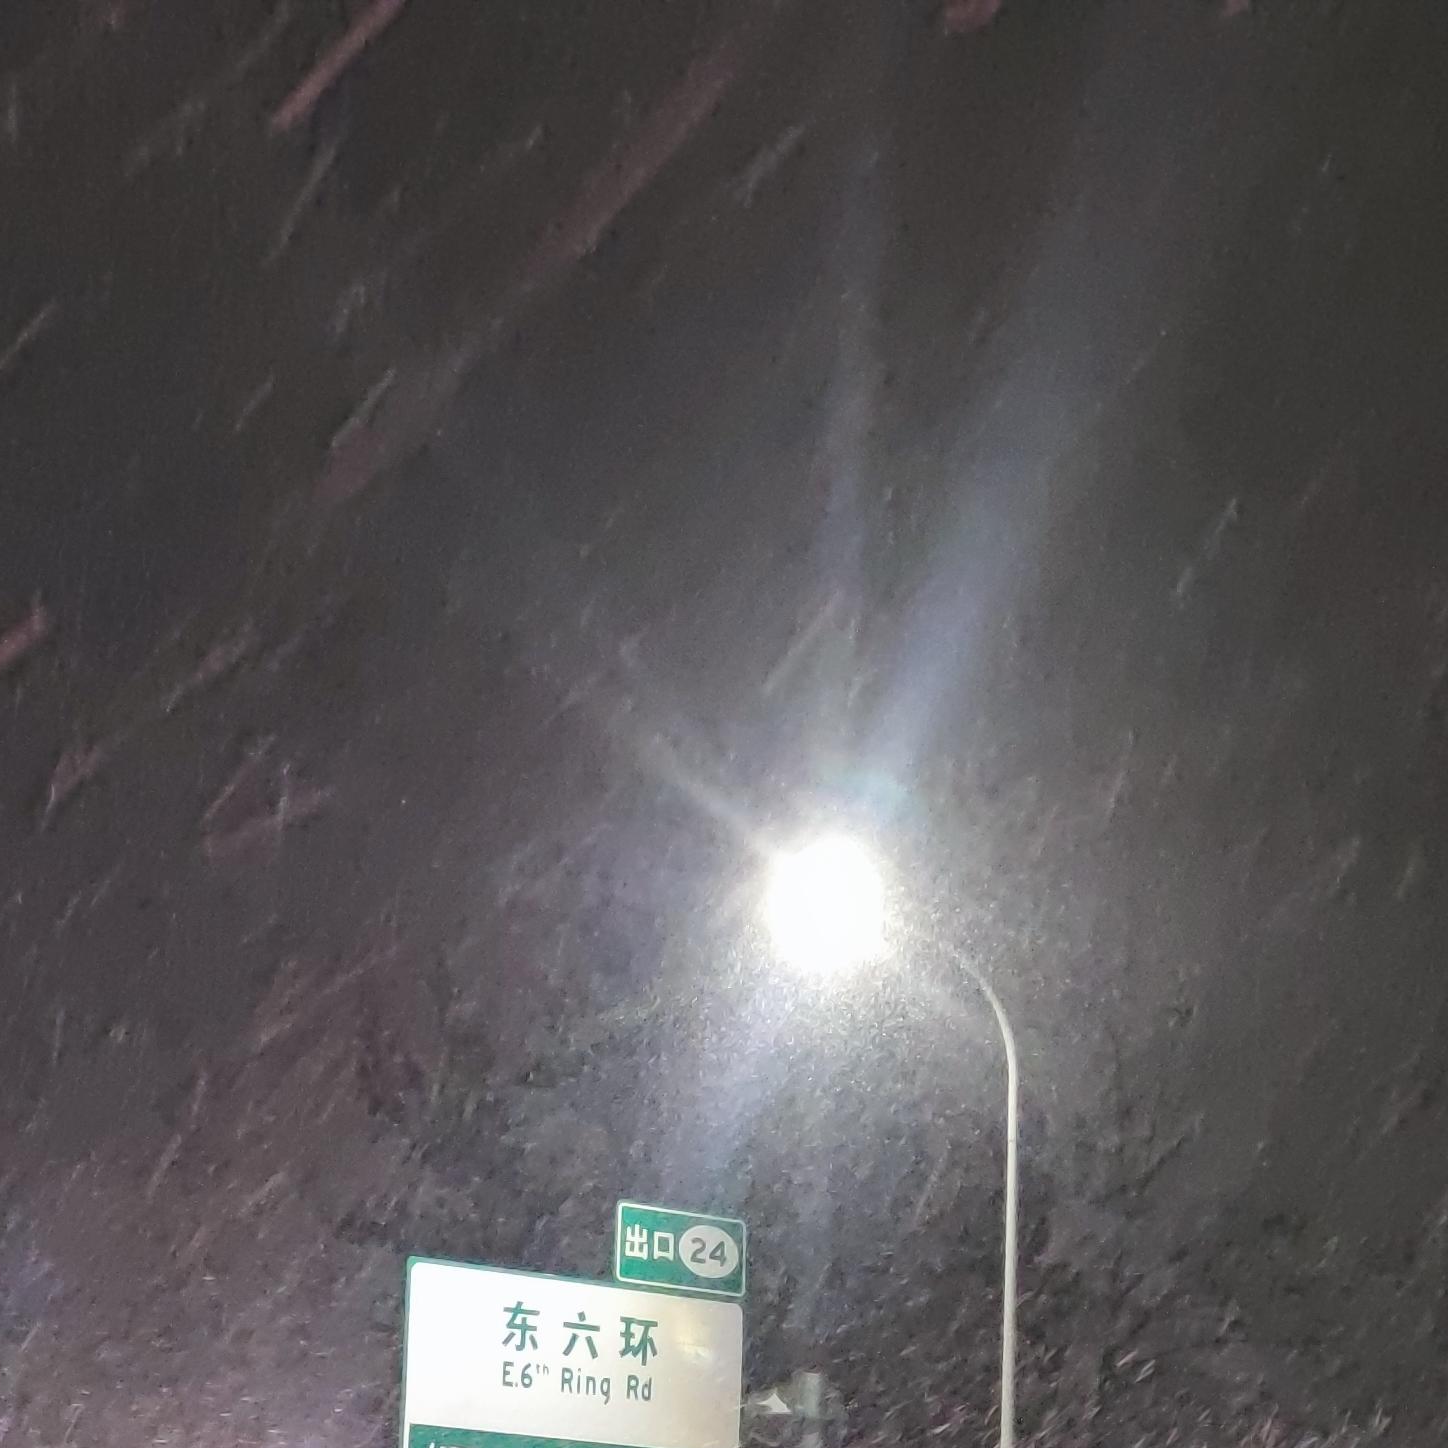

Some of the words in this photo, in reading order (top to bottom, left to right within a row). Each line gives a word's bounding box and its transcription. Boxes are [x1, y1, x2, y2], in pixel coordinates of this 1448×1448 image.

[624, 1223, 674, 1261] 出口
[690, 1237, 727, 1267] 24
[502, 1300, 659, 1367] 东六环
[560, 1366, 612, 1405] Ring
[626, 1374, 653, 1401] Rd
